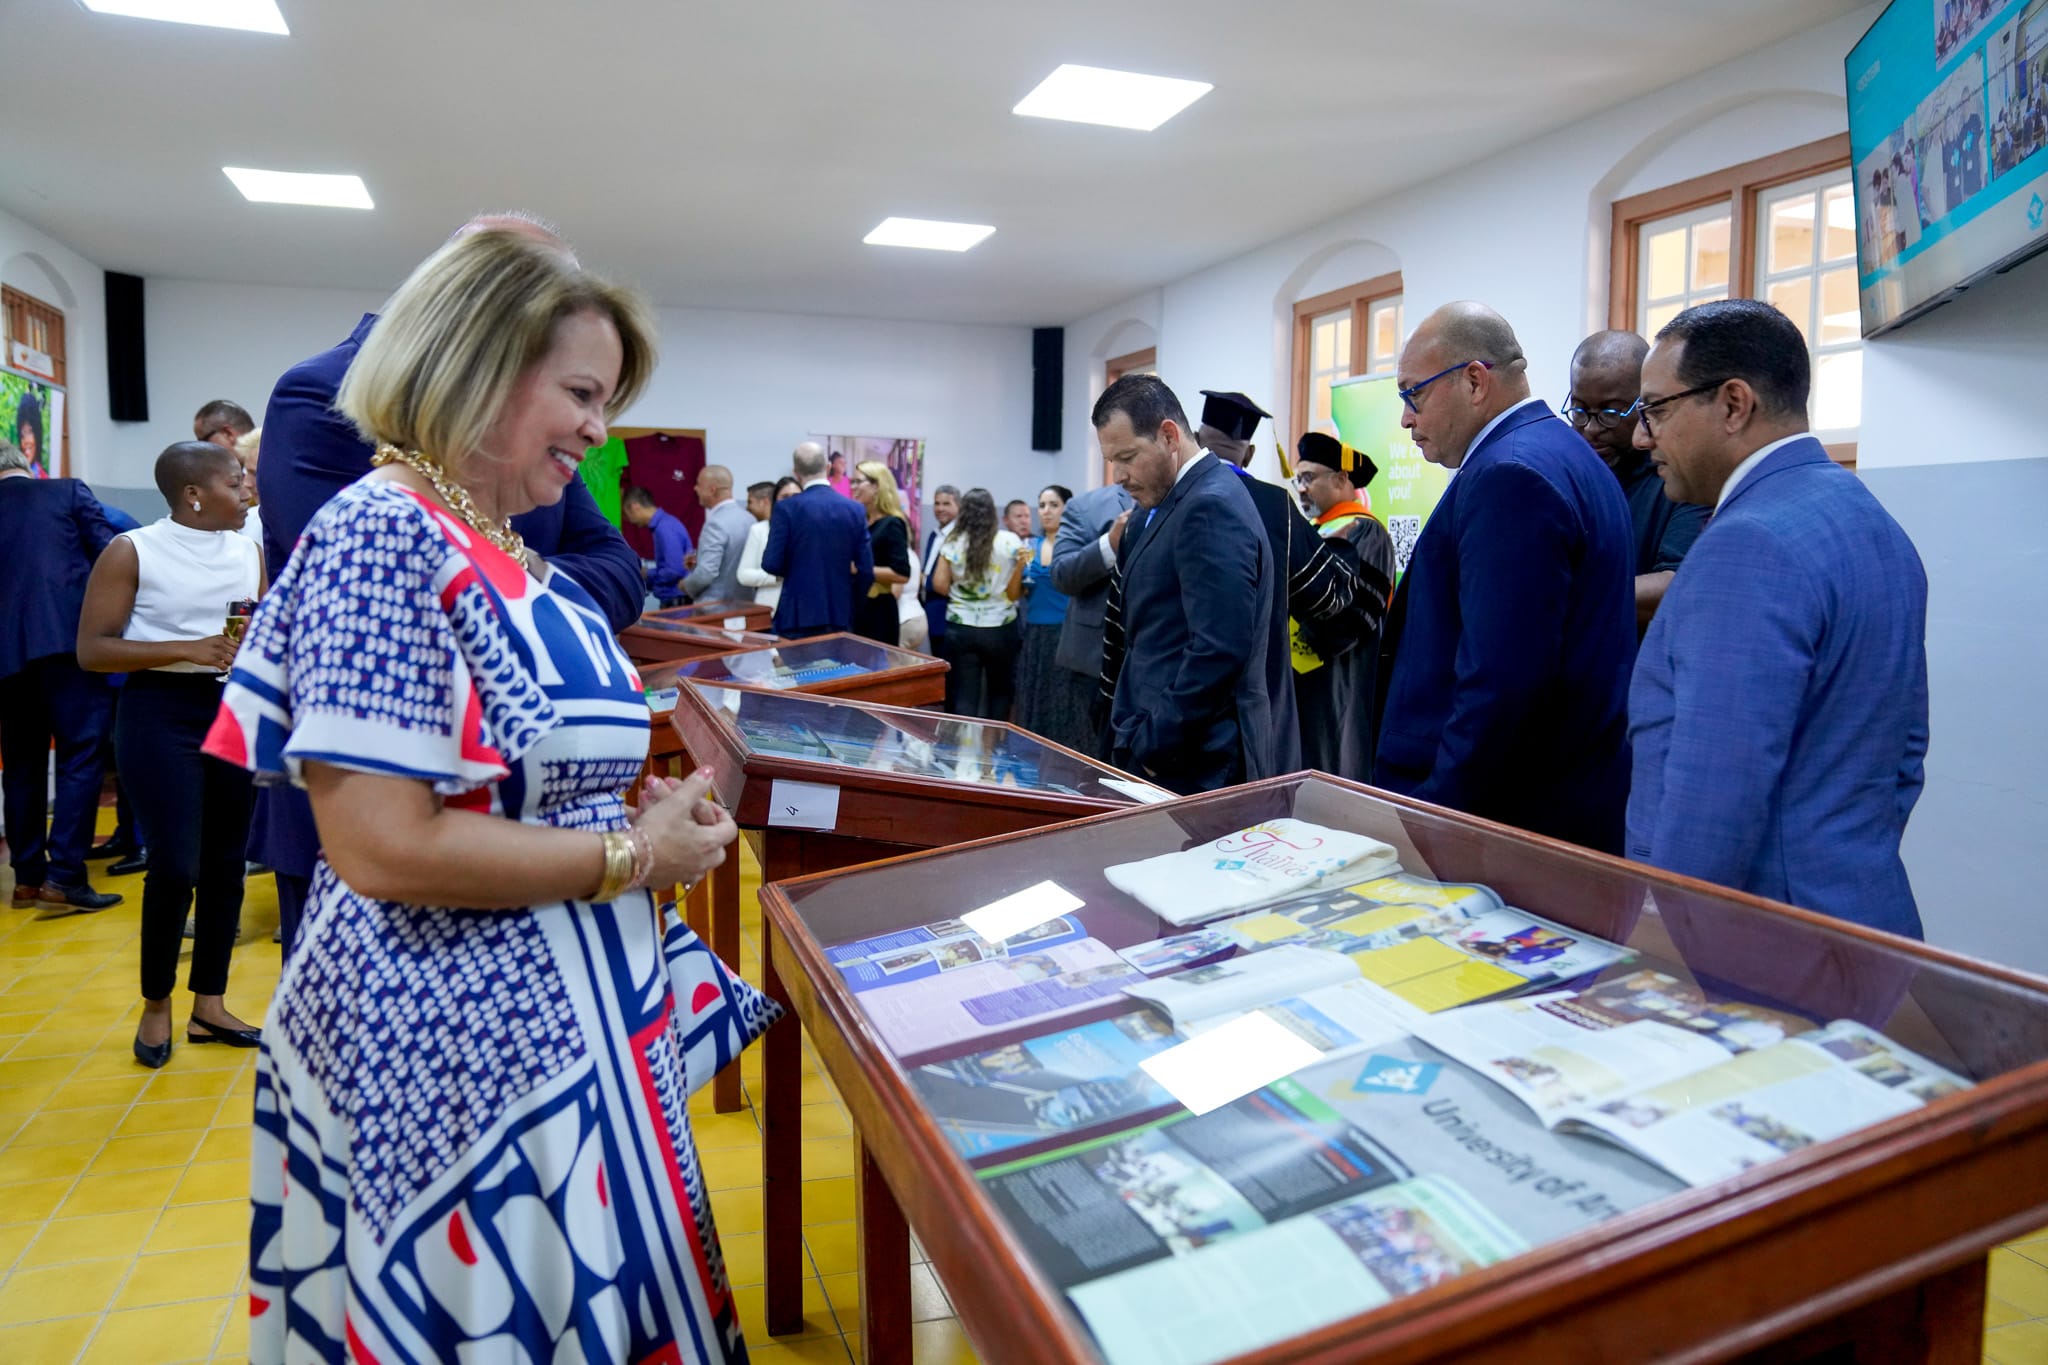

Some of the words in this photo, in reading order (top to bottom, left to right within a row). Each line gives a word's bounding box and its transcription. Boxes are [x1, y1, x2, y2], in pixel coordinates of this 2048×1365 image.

[1389, 443, 1407, 460] We
[1388, 462, 1422, 480] about
[1388, 481, 1411, 504] you!
[1422, 1097, 1545, 1184] University
[1534, 1176, 1587, 1200] of
